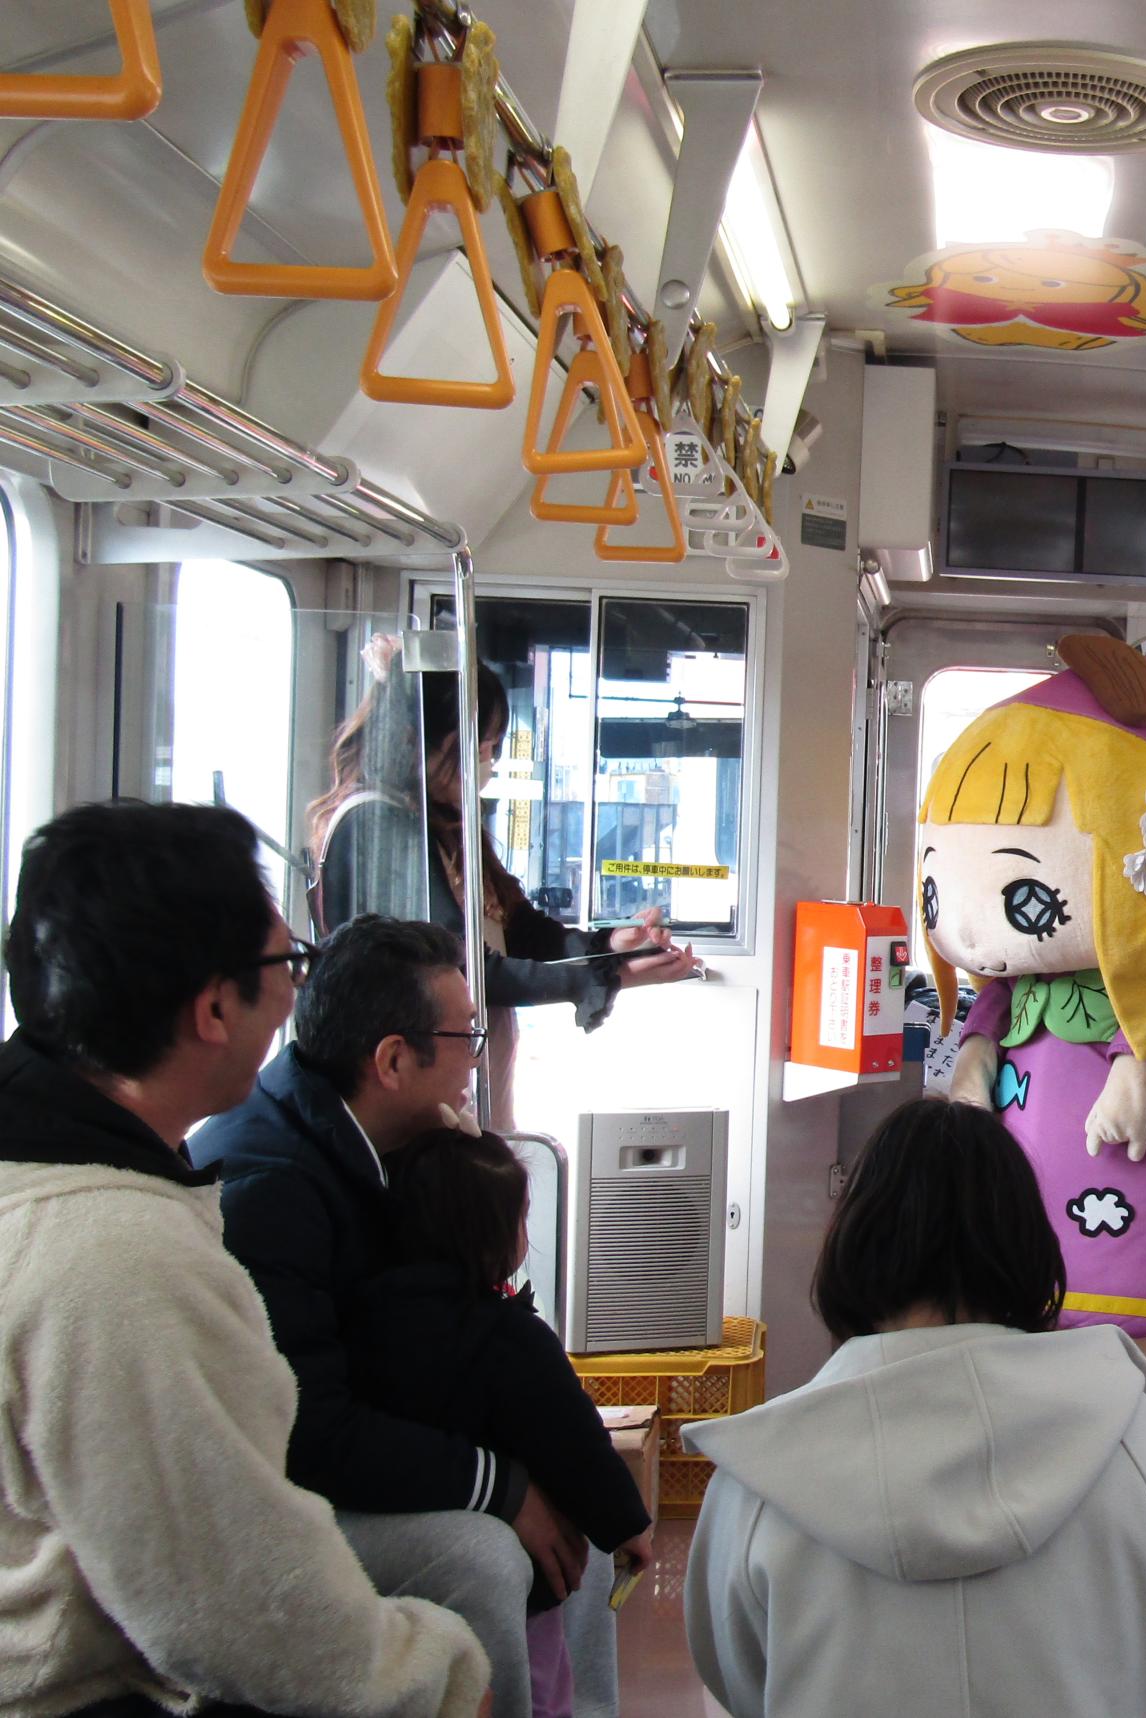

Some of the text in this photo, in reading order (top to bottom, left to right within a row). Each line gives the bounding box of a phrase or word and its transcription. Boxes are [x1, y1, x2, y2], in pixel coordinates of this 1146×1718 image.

[674, 441, 698, 468] 禁
[607, 863, 725, 878] ご用件は、停車中にお願いします。
[868, 956, 882, 1017] 整理券
